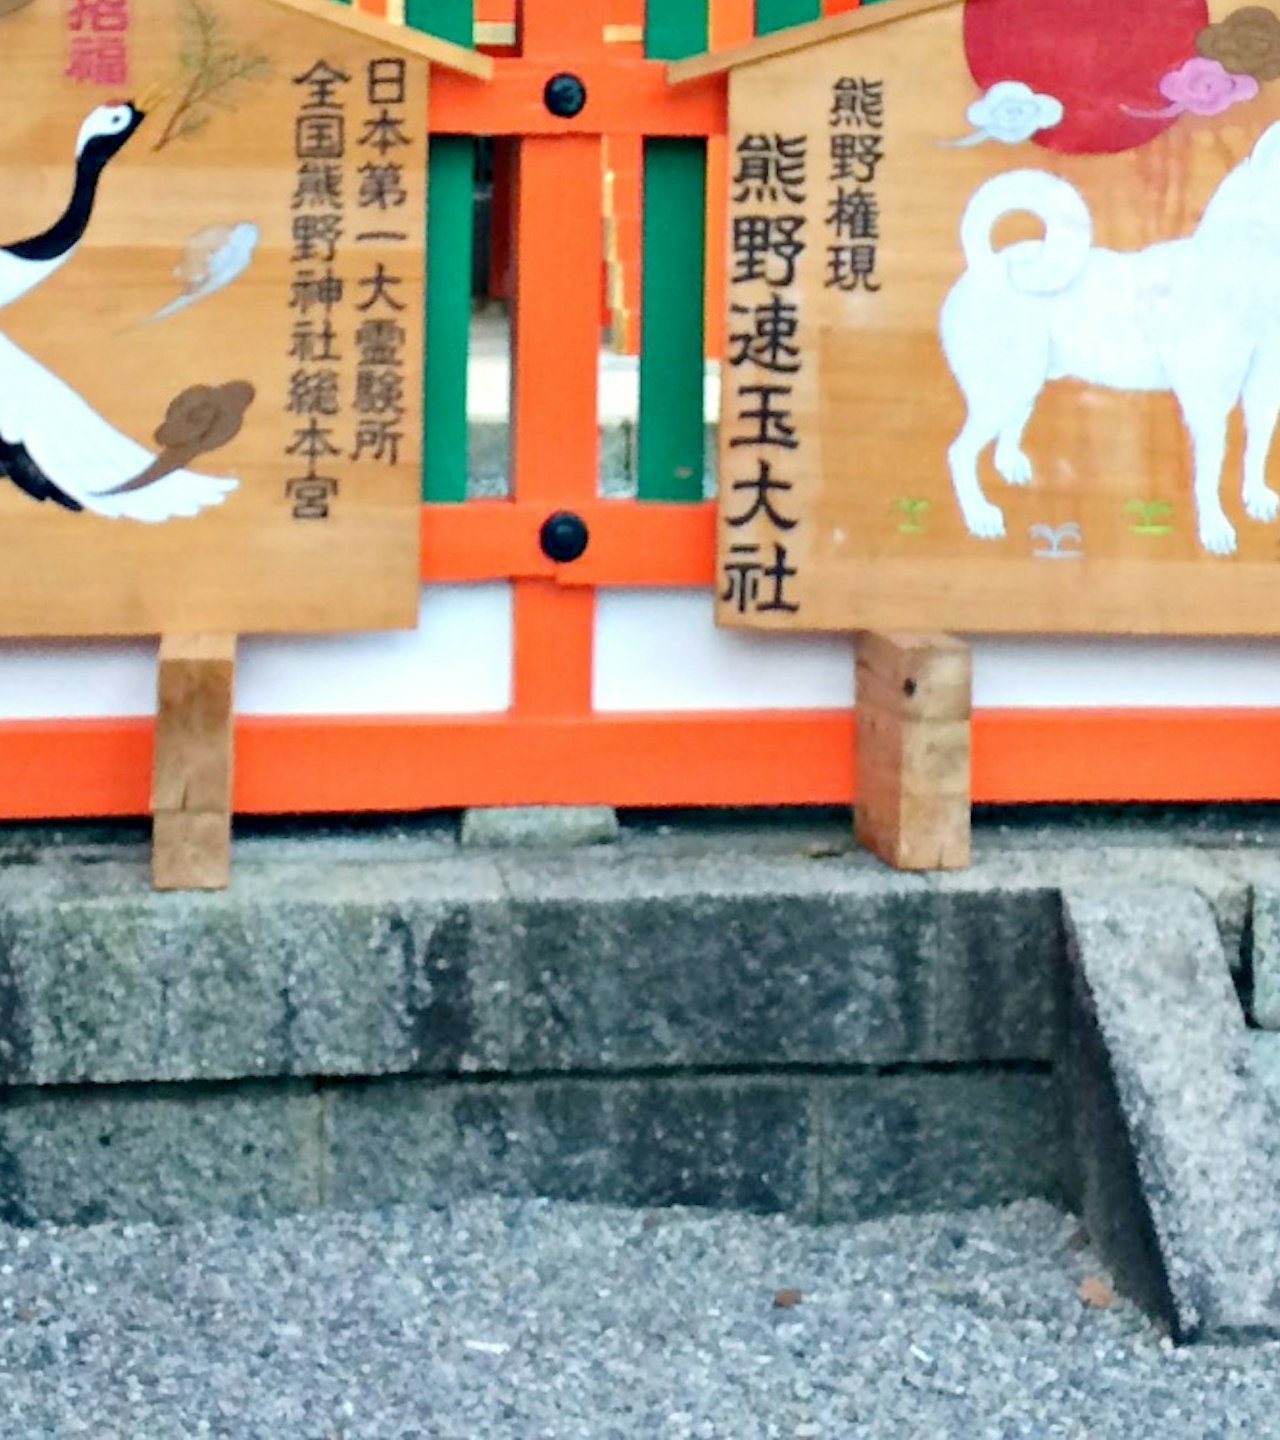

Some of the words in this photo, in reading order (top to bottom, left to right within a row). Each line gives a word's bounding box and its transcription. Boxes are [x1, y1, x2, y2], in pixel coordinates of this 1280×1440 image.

[285, 58, 353, 520] 全国熊野神社総本宮
[722, 133, 807, 615] 熊野速玉大社
[824, 76, 885, 292] 熊野権現
